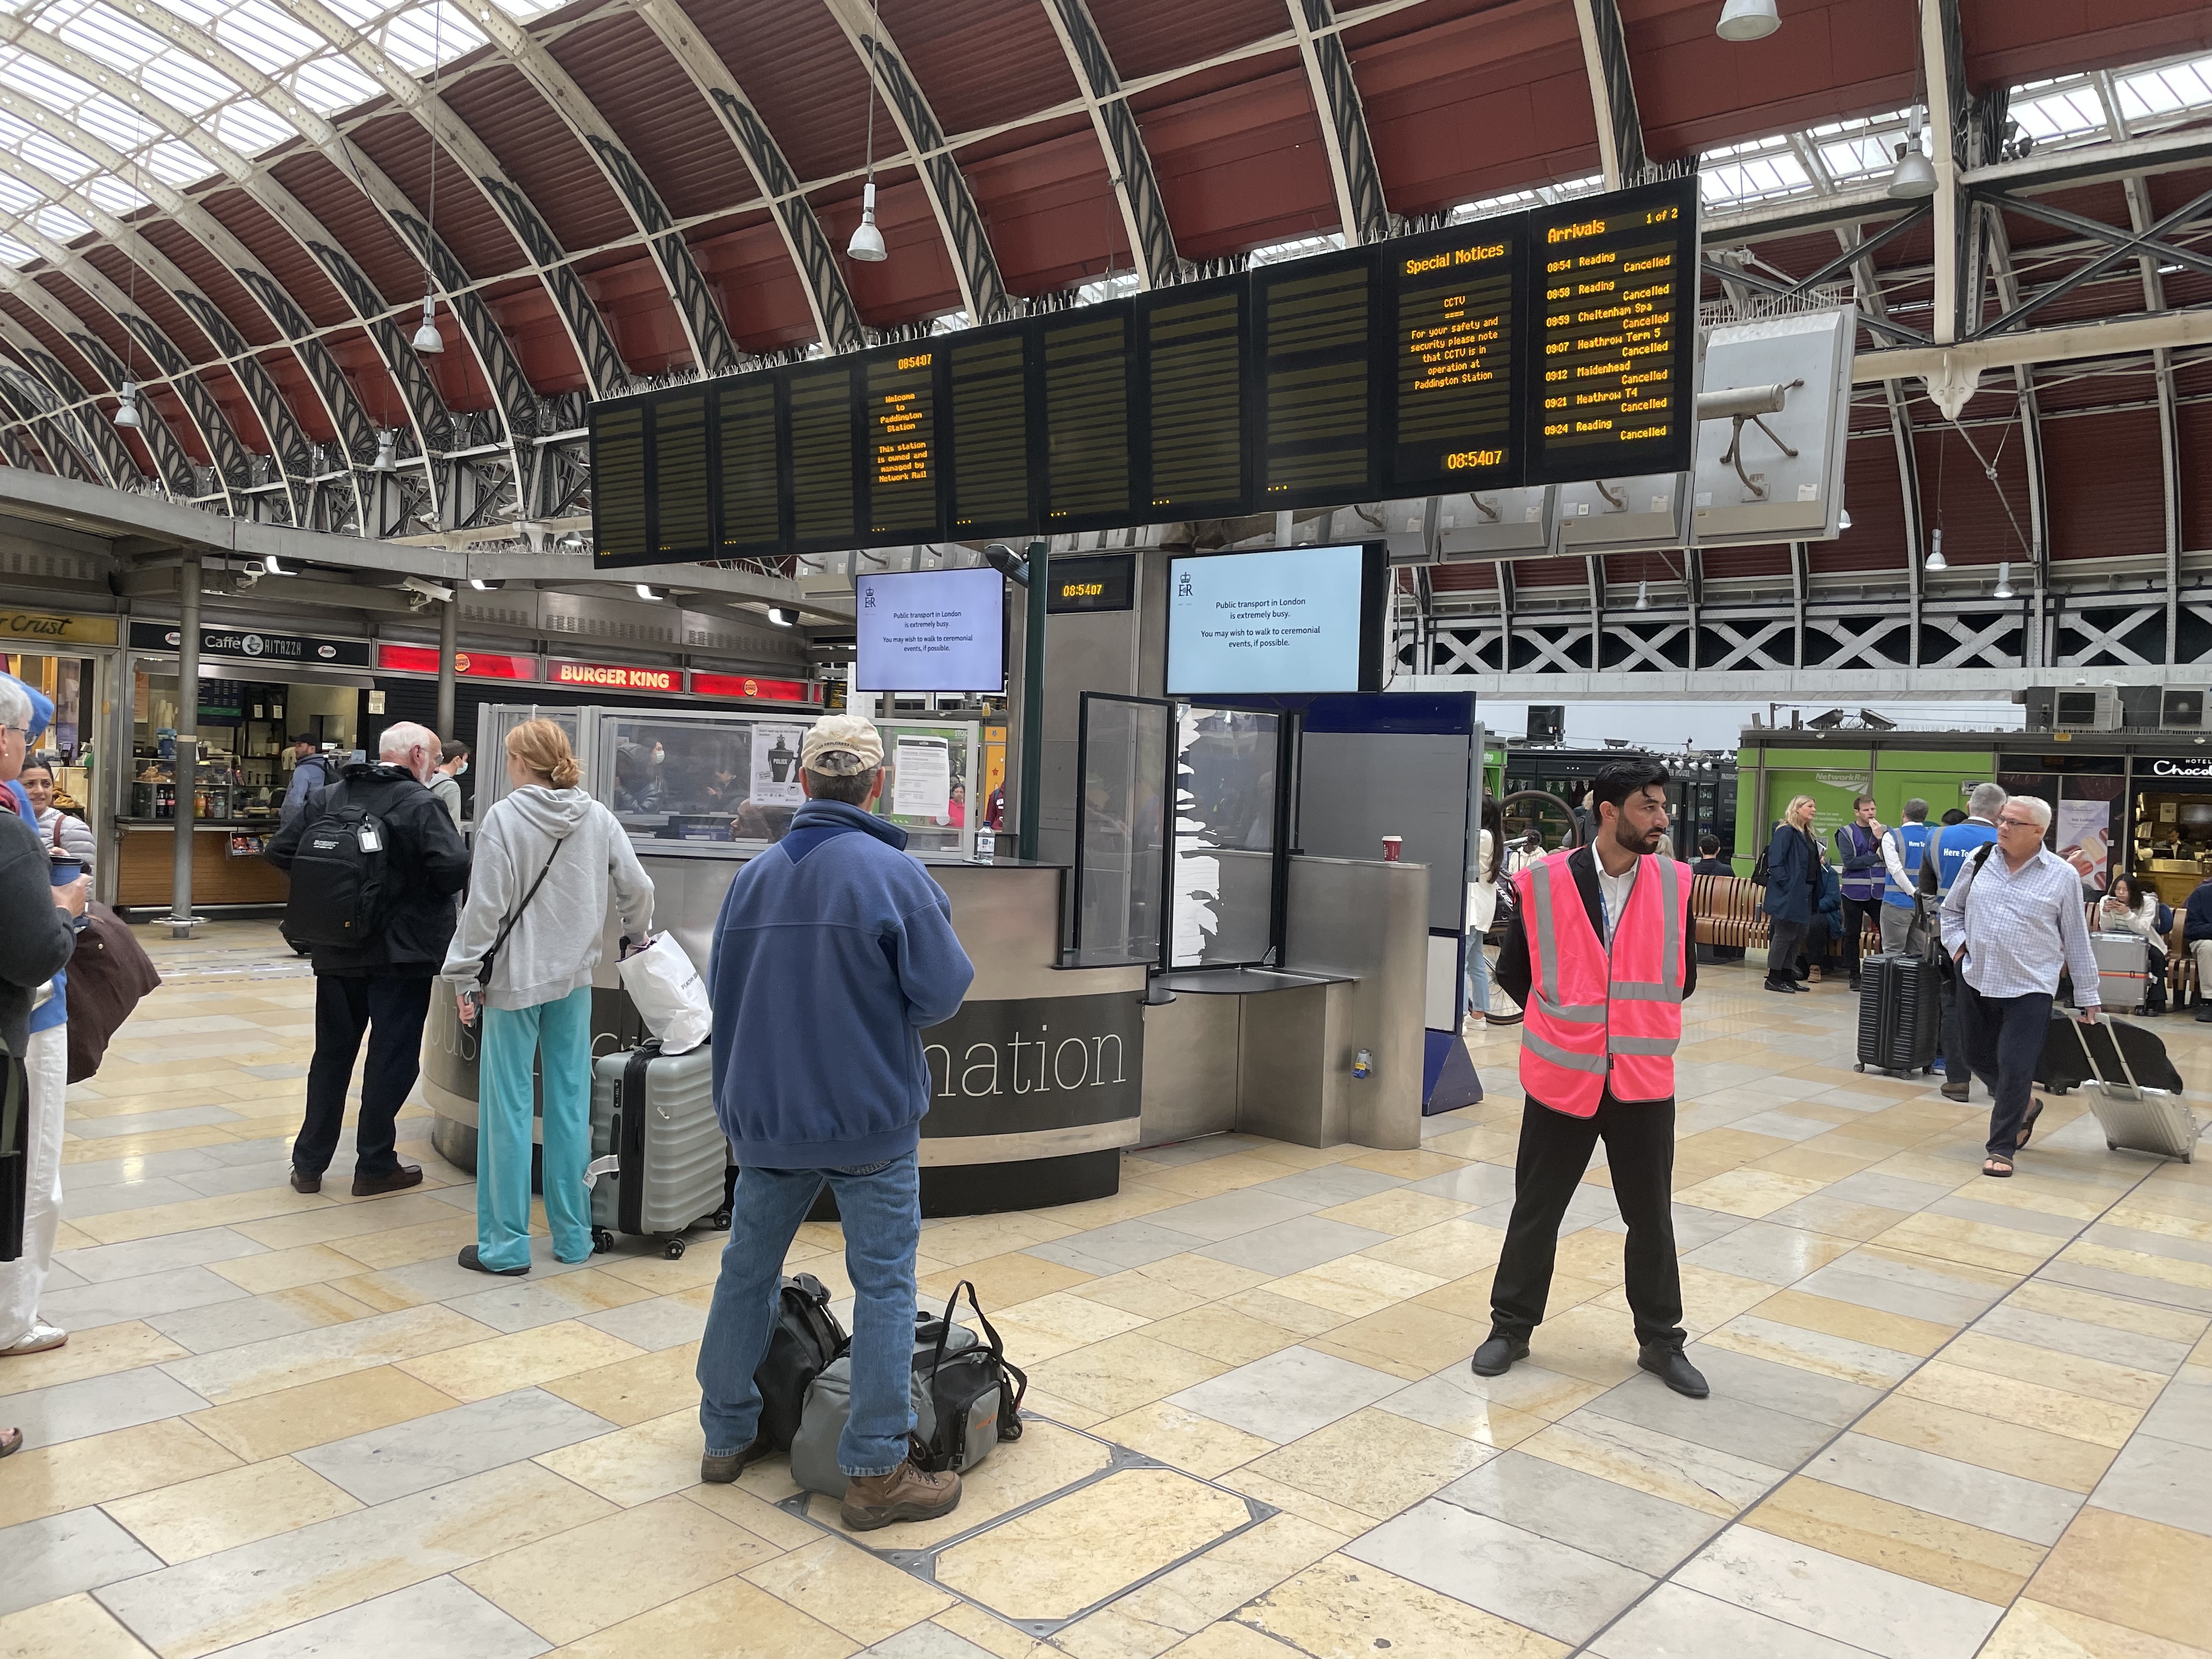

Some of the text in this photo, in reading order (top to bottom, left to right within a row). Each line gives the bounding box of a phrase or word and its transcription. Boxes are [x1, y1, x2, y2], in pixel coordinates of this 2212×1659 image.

[1646, 208, 1678, 224] 1 of 2
[1548, 220, 1605, 243] Arrivals
[1407, 244, 1504, 274] Special Notices
[1547, 253, 1615, 272] 08:54 Reading
[1623, 255, 1670, 272] Cancelled
[1547, 281, 1614, 300] 08:58 Reading
[1623, 284, 1669, 301] Cancelled
[1444, 296, 1465, 308] CCTV
[1546, 302, 1652, 327] 08:59 Cheltenham Spa
[1623, 312, 1669, 329] Cancelled
[1411, 317, 1498, 339] For your safety and
[1410, 331, 1498, 352] security please note
[1546, 328, 1661, 354] 09:07 Heathrow Term 5
[1622, 341, 1668, 357] Cancelled
[1423, 346, 1486, 363] that CCTV is in
[1427, 359, 1480, 376] operation at
[1545, 361, 1630, 382] 09:12 Maidenhead
[1415, 371, 1493, 390] Paddington Station
[1621, 369, 1668, 385] Cancelled
[885, 393, 915, 403] Welcome
[1545, 388, 1638, 409] 09:21 Heathrow T4
[1621, 398, 1667, 413] Cancelled
[880, 413, 922, 424] Paddington
[887, 424, 915, 433] Station
[1544, 420, 1612, 435] 09:24 Reading
[1620, 426, 1666, 440] Cancelled
[898, 442, 926, 451] station
[888, 454, 910, 462] owned
[881, 462, 924, 473] managed by
[879, 471, 927, 483] Network Rail
[1216, 601, 1237, 609] Public
[1238, 600, 1269, 609] transport
[1237, 611, 1271, 619] extremely
[10, 615, 72, 635] Crust
[1281, 626, 1321, 635] ceremonial
[205, 635, 241, 649] Caffè
[1260, 639, 1290, 648] possible.
[561, 665, 669, 688] BURGER KING
[1944, 848, 1960, 856] Here
